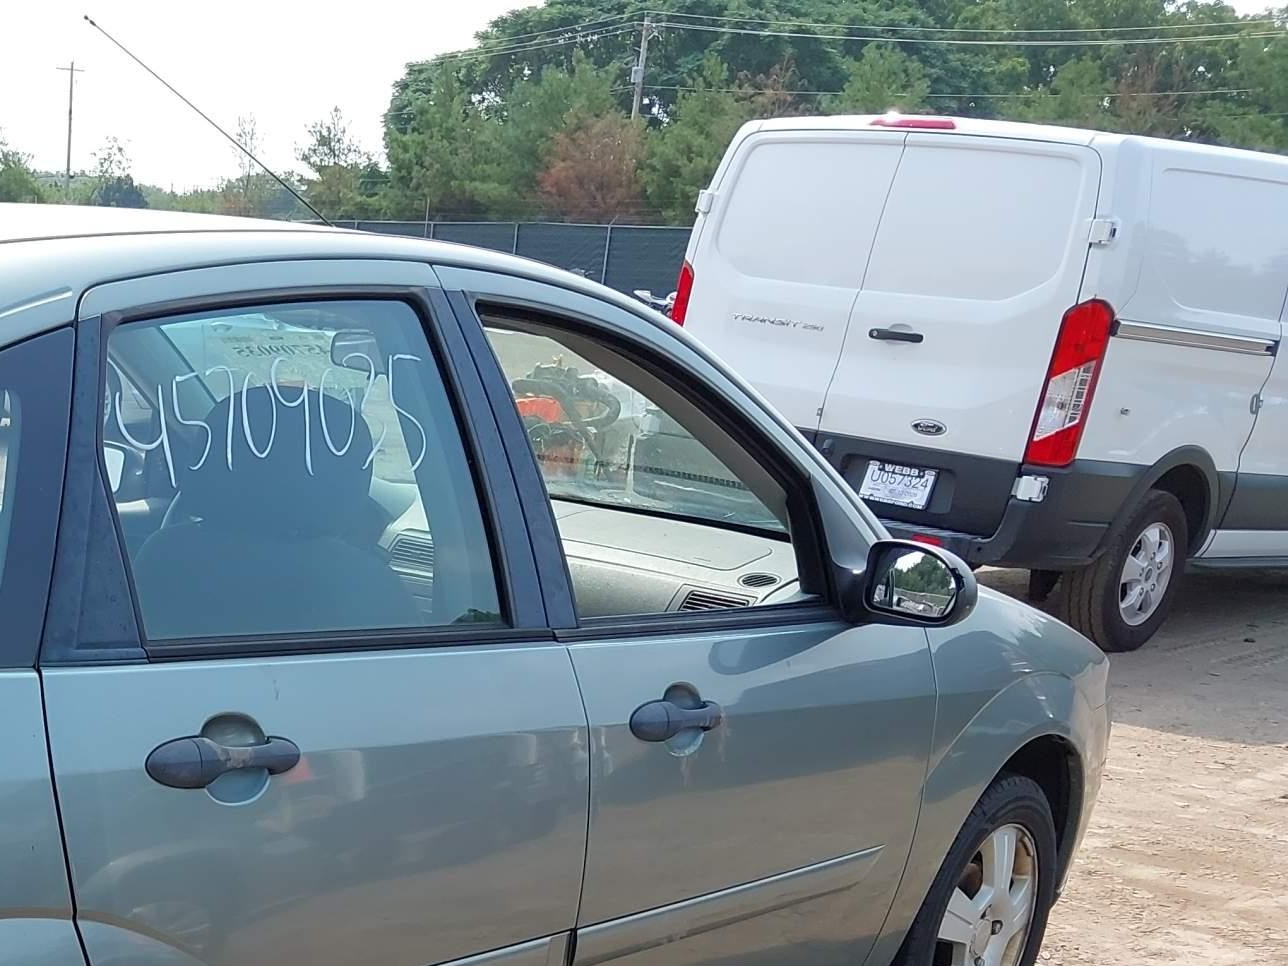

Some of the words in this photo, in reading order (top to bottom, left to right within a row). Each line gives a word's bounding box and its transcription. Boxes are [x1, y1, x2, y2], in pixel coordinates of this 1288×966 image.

[731, 312, 801, 328] TRANSIT
[115, 352, 426, 489] 45709035
[884, 463, 919, 477] WEBB
[870, 469, 929, 490] U057324
